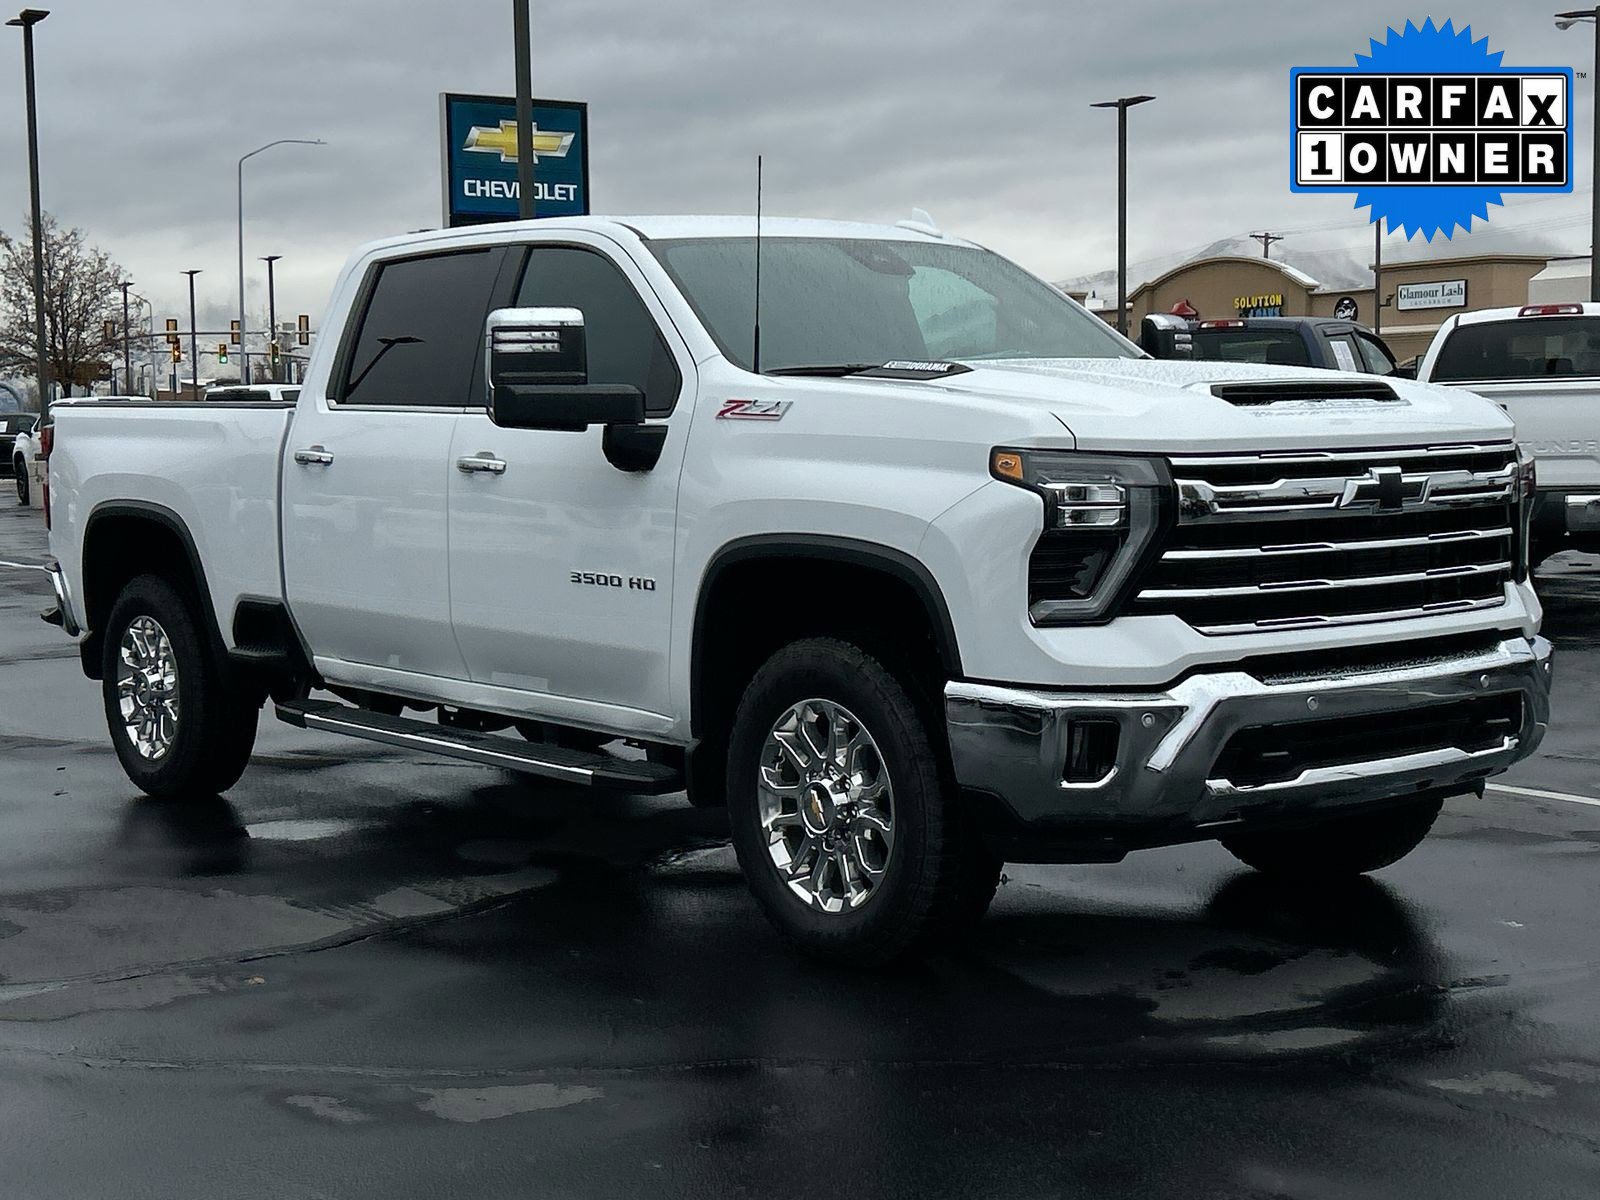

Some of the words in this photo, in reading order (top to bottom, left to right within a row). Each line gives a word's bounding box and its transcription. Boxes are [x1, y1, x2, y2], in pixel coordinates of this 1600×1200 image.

[463, 179, 578, 201] CHEVOLET
[1399, 287, 1439, 300] Glamour
[1441, 283, 1463, 297] Lash
[1233, 294, 1282, 309] SOLUTION
[570, 571, 622, 587] 3500
[628, 576, 656, 591] HD
